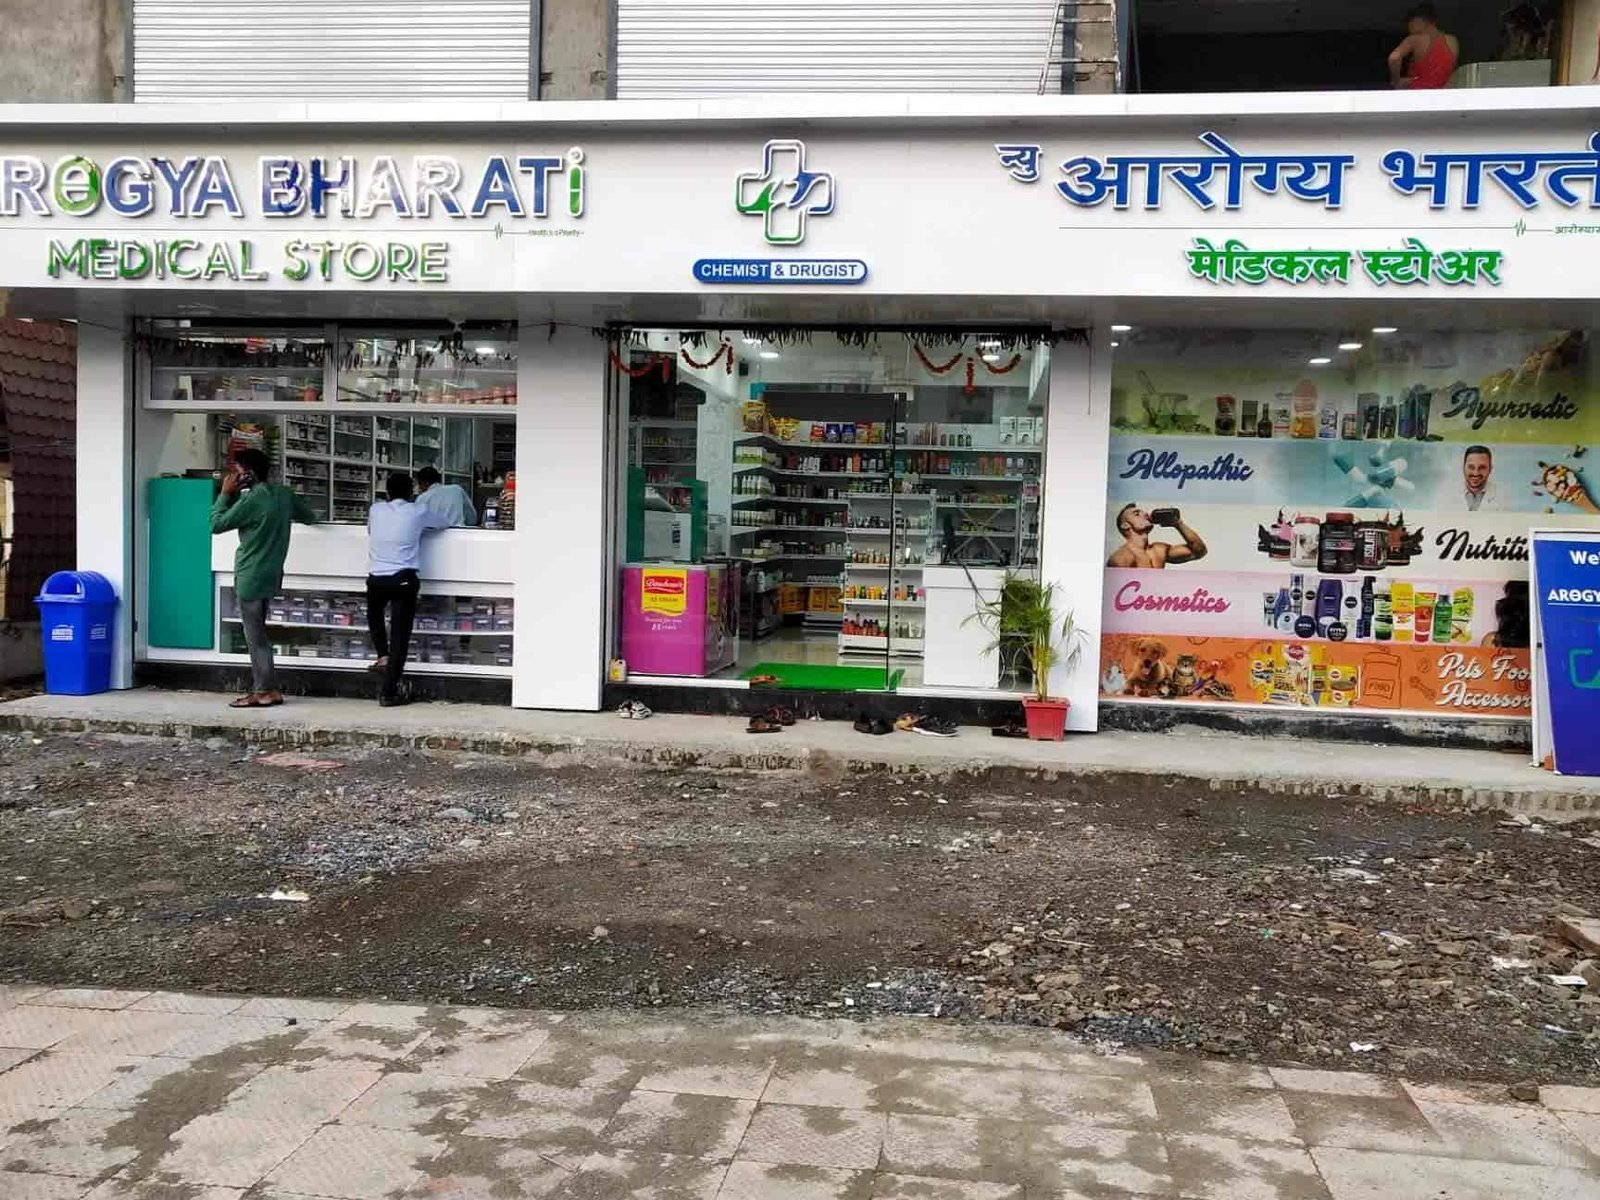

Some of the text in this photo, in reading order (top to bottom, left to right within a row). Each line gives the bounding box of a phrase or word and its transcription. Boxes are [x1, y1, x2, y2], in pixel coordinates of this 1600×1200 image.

[1055, 132, 1355, 209] आरोग्य
[48, 239, 449, 282] MEDICAL STORE
[701, 264, 857, 277] CHEMIST & DRUGIST
[1185, 237, 1503, 286] मेडिकल स्टोअर
[1443, 386, 1578, 430] Ayurvedic
[1119, 449, 1254, 489] Allopathic
[1115, 580, 1230, 612] Cosmetics
[1438, 652, 1531, 681] Pets Foo
